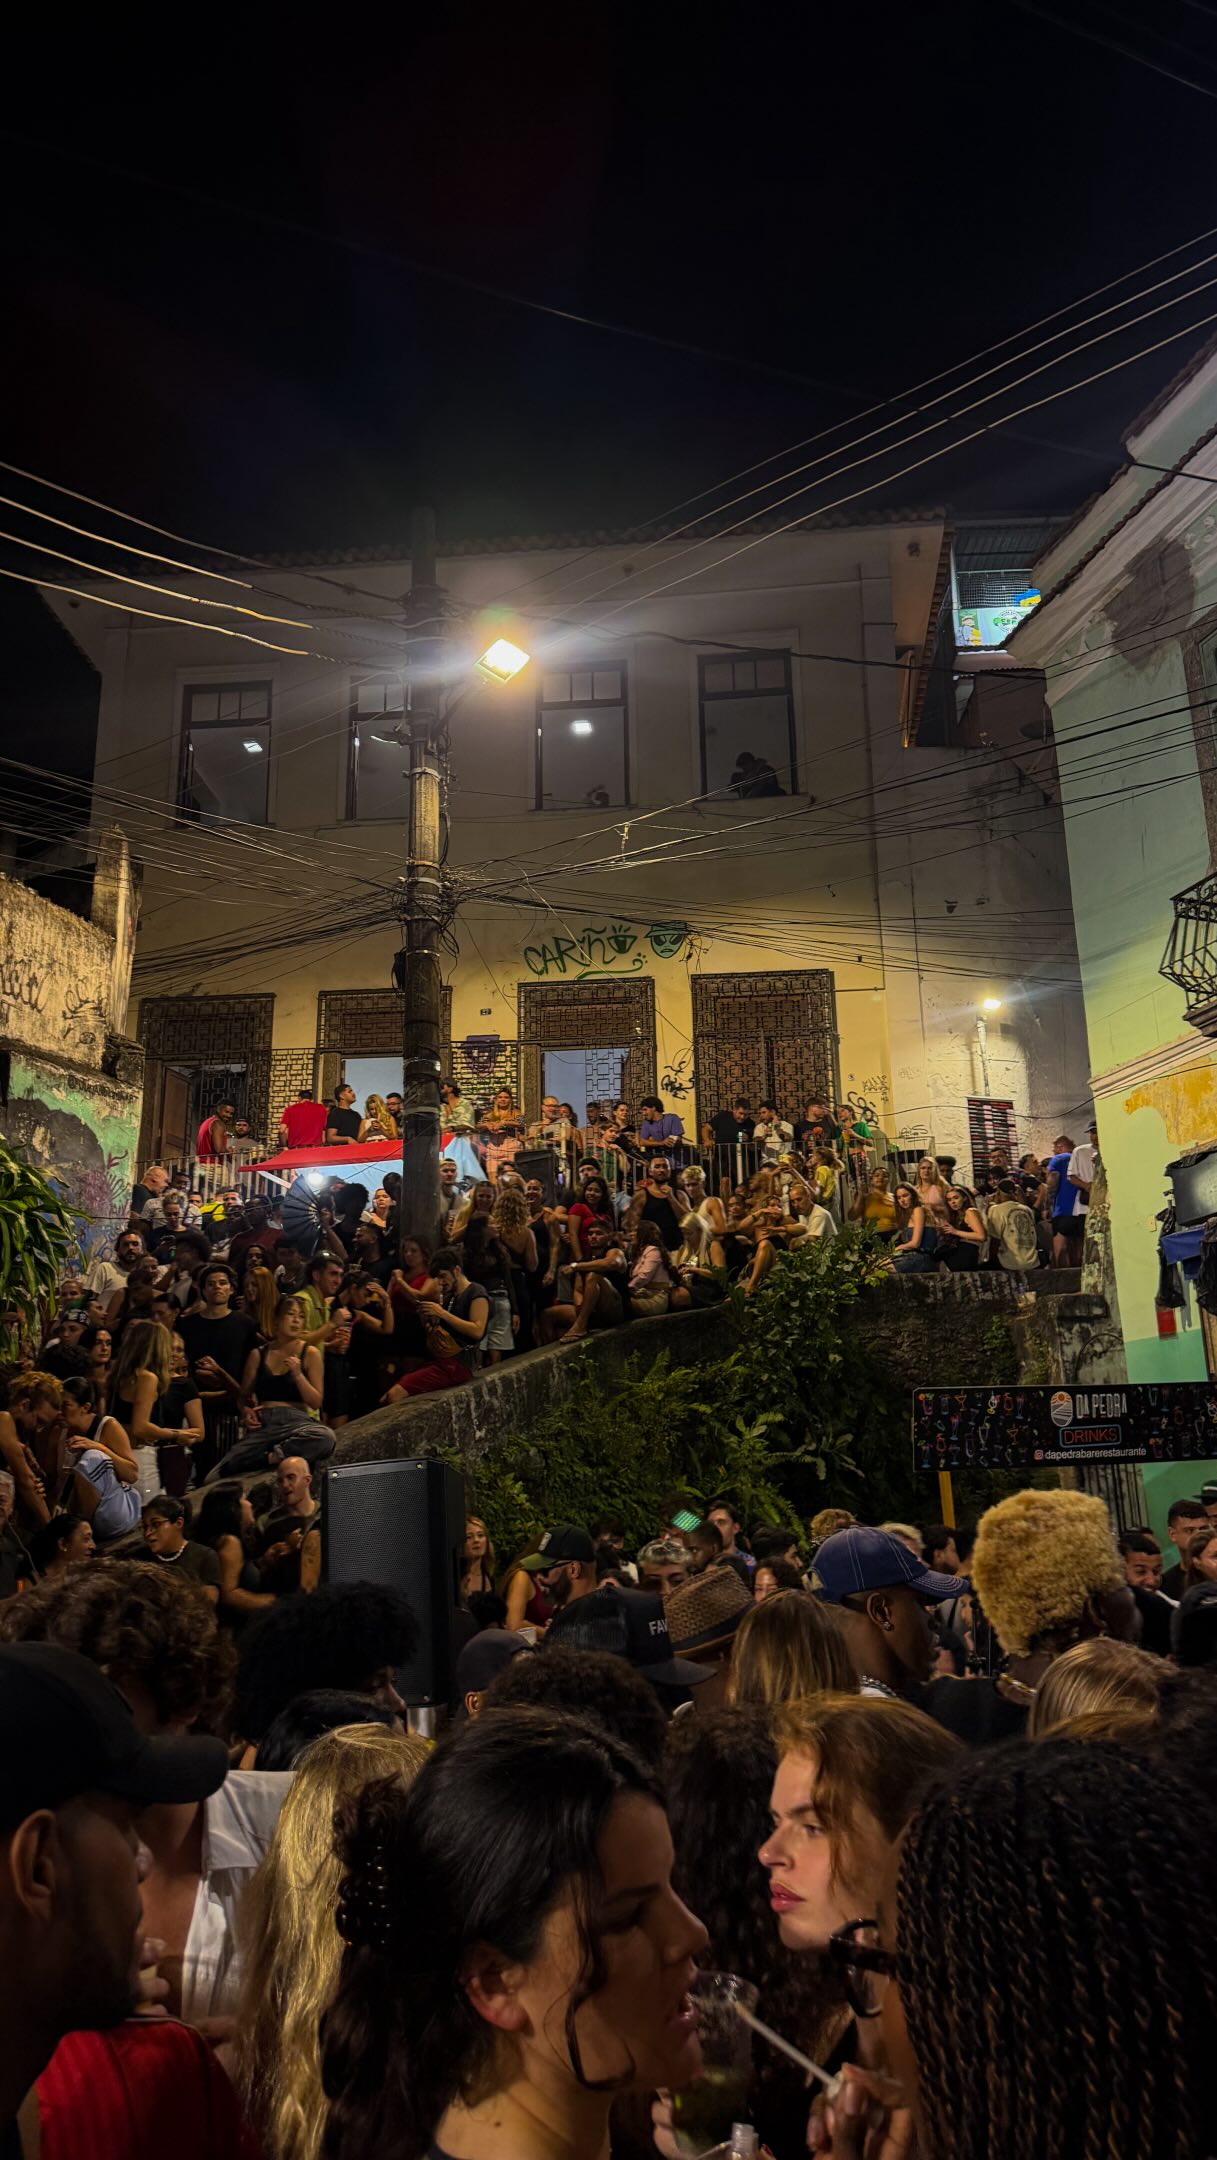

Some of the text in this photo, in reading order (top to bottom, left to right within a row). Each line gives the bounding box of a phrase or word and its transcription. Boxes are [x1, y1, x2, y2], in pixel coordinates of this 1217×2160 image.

[1076, 1392, 1128, 1420] DA PEDRA
[1063, 1427, 1118, 1444] DRINKS
